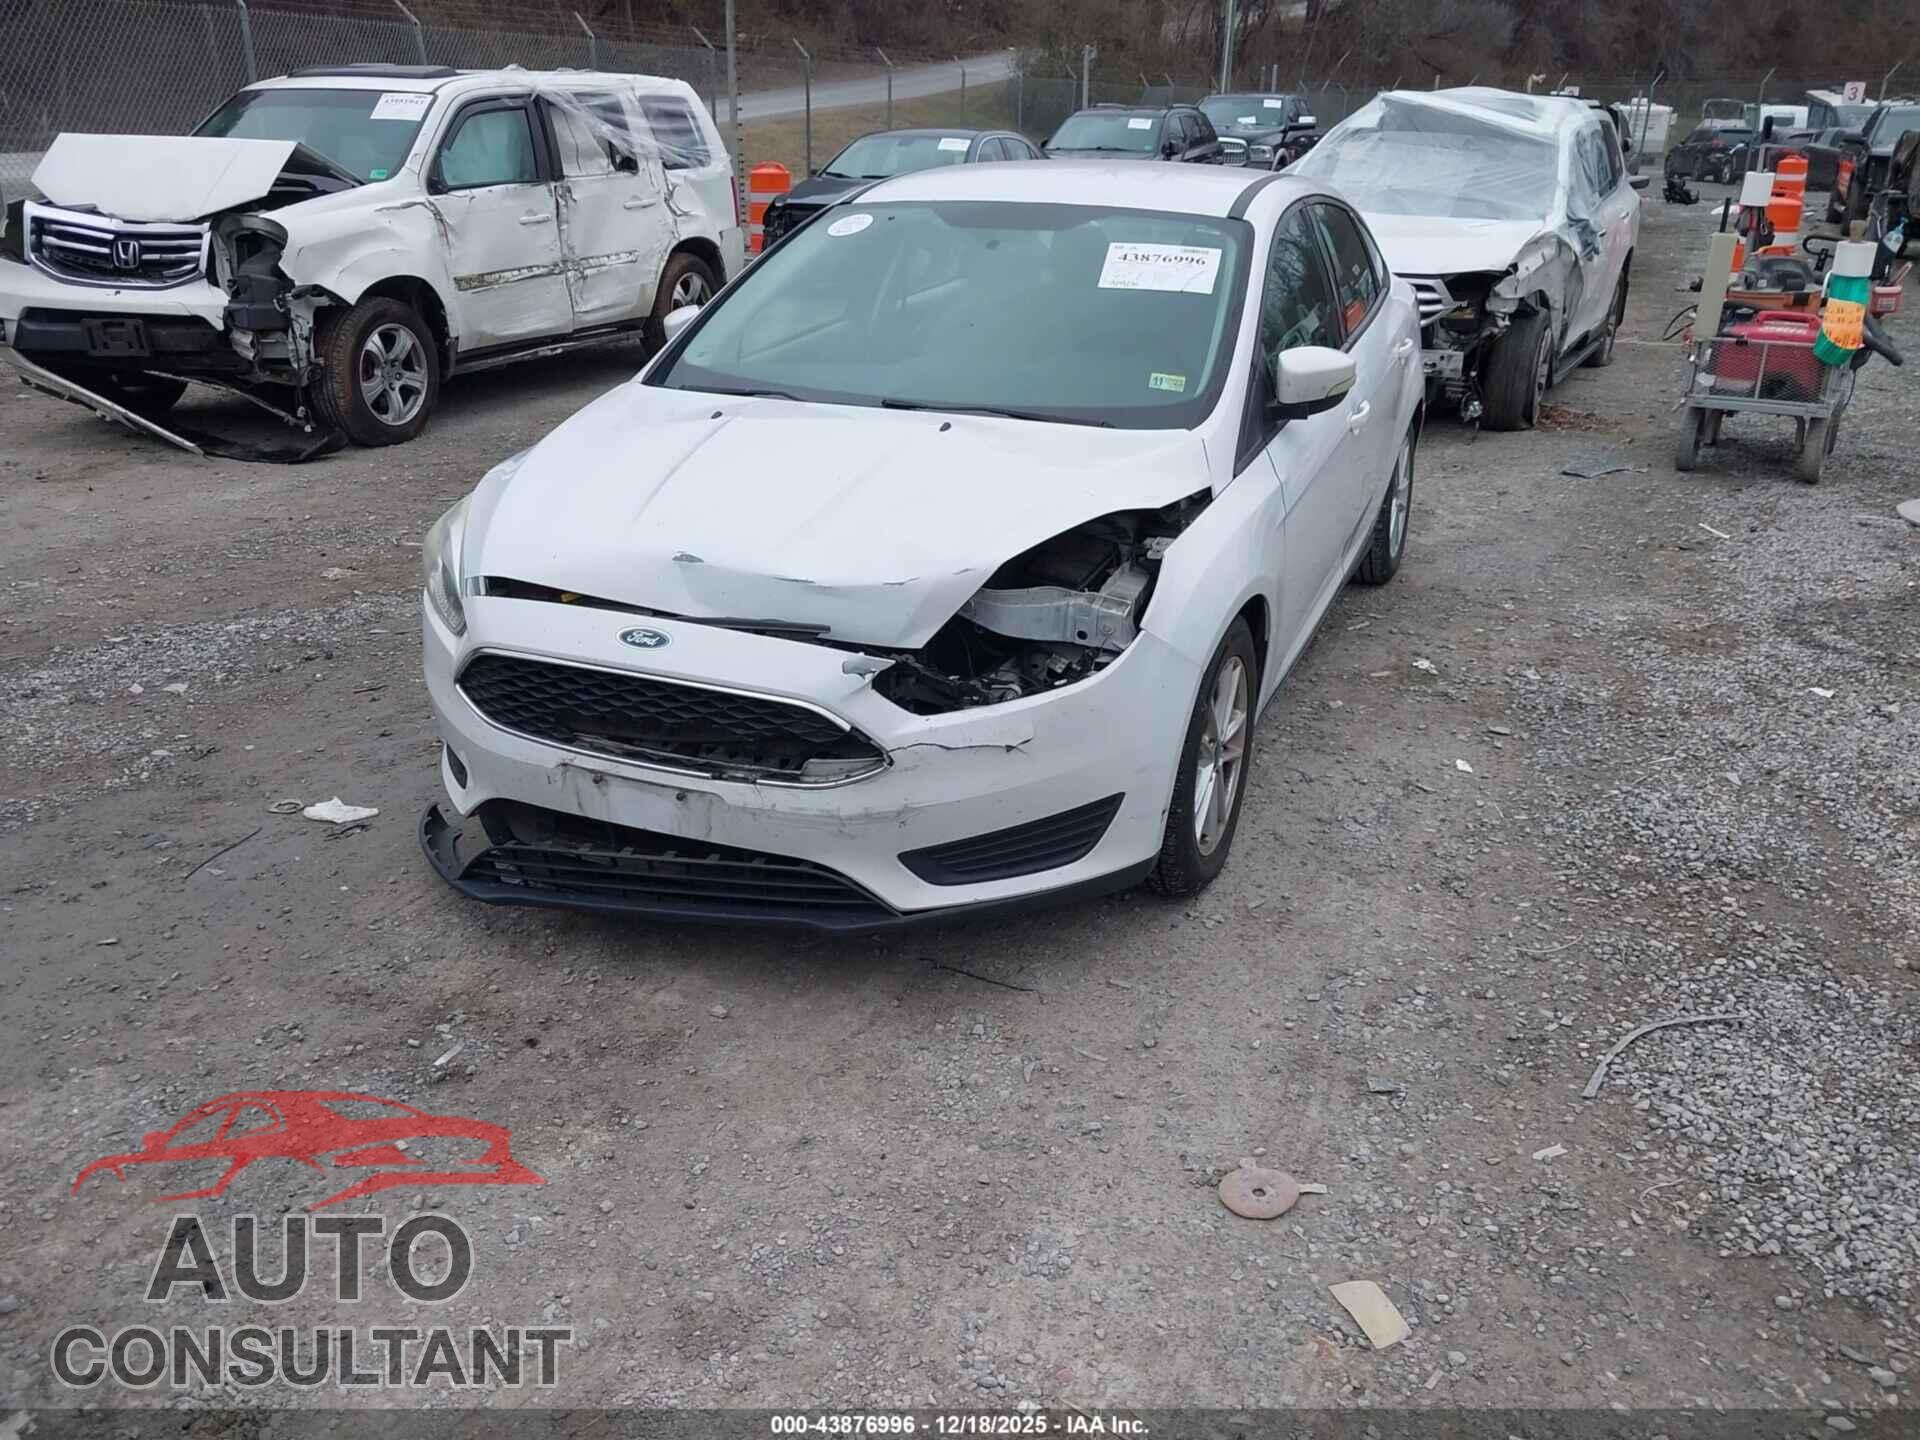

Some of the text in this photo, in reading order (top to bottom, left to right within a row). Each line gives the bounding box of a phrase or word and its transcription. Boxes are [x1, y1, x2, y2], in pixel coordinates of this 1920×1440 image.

[1848, 87, 1858, 101] 3
[1117, 253, 1206, 266] 43876996
[627, 631, 660, 646] Ford
